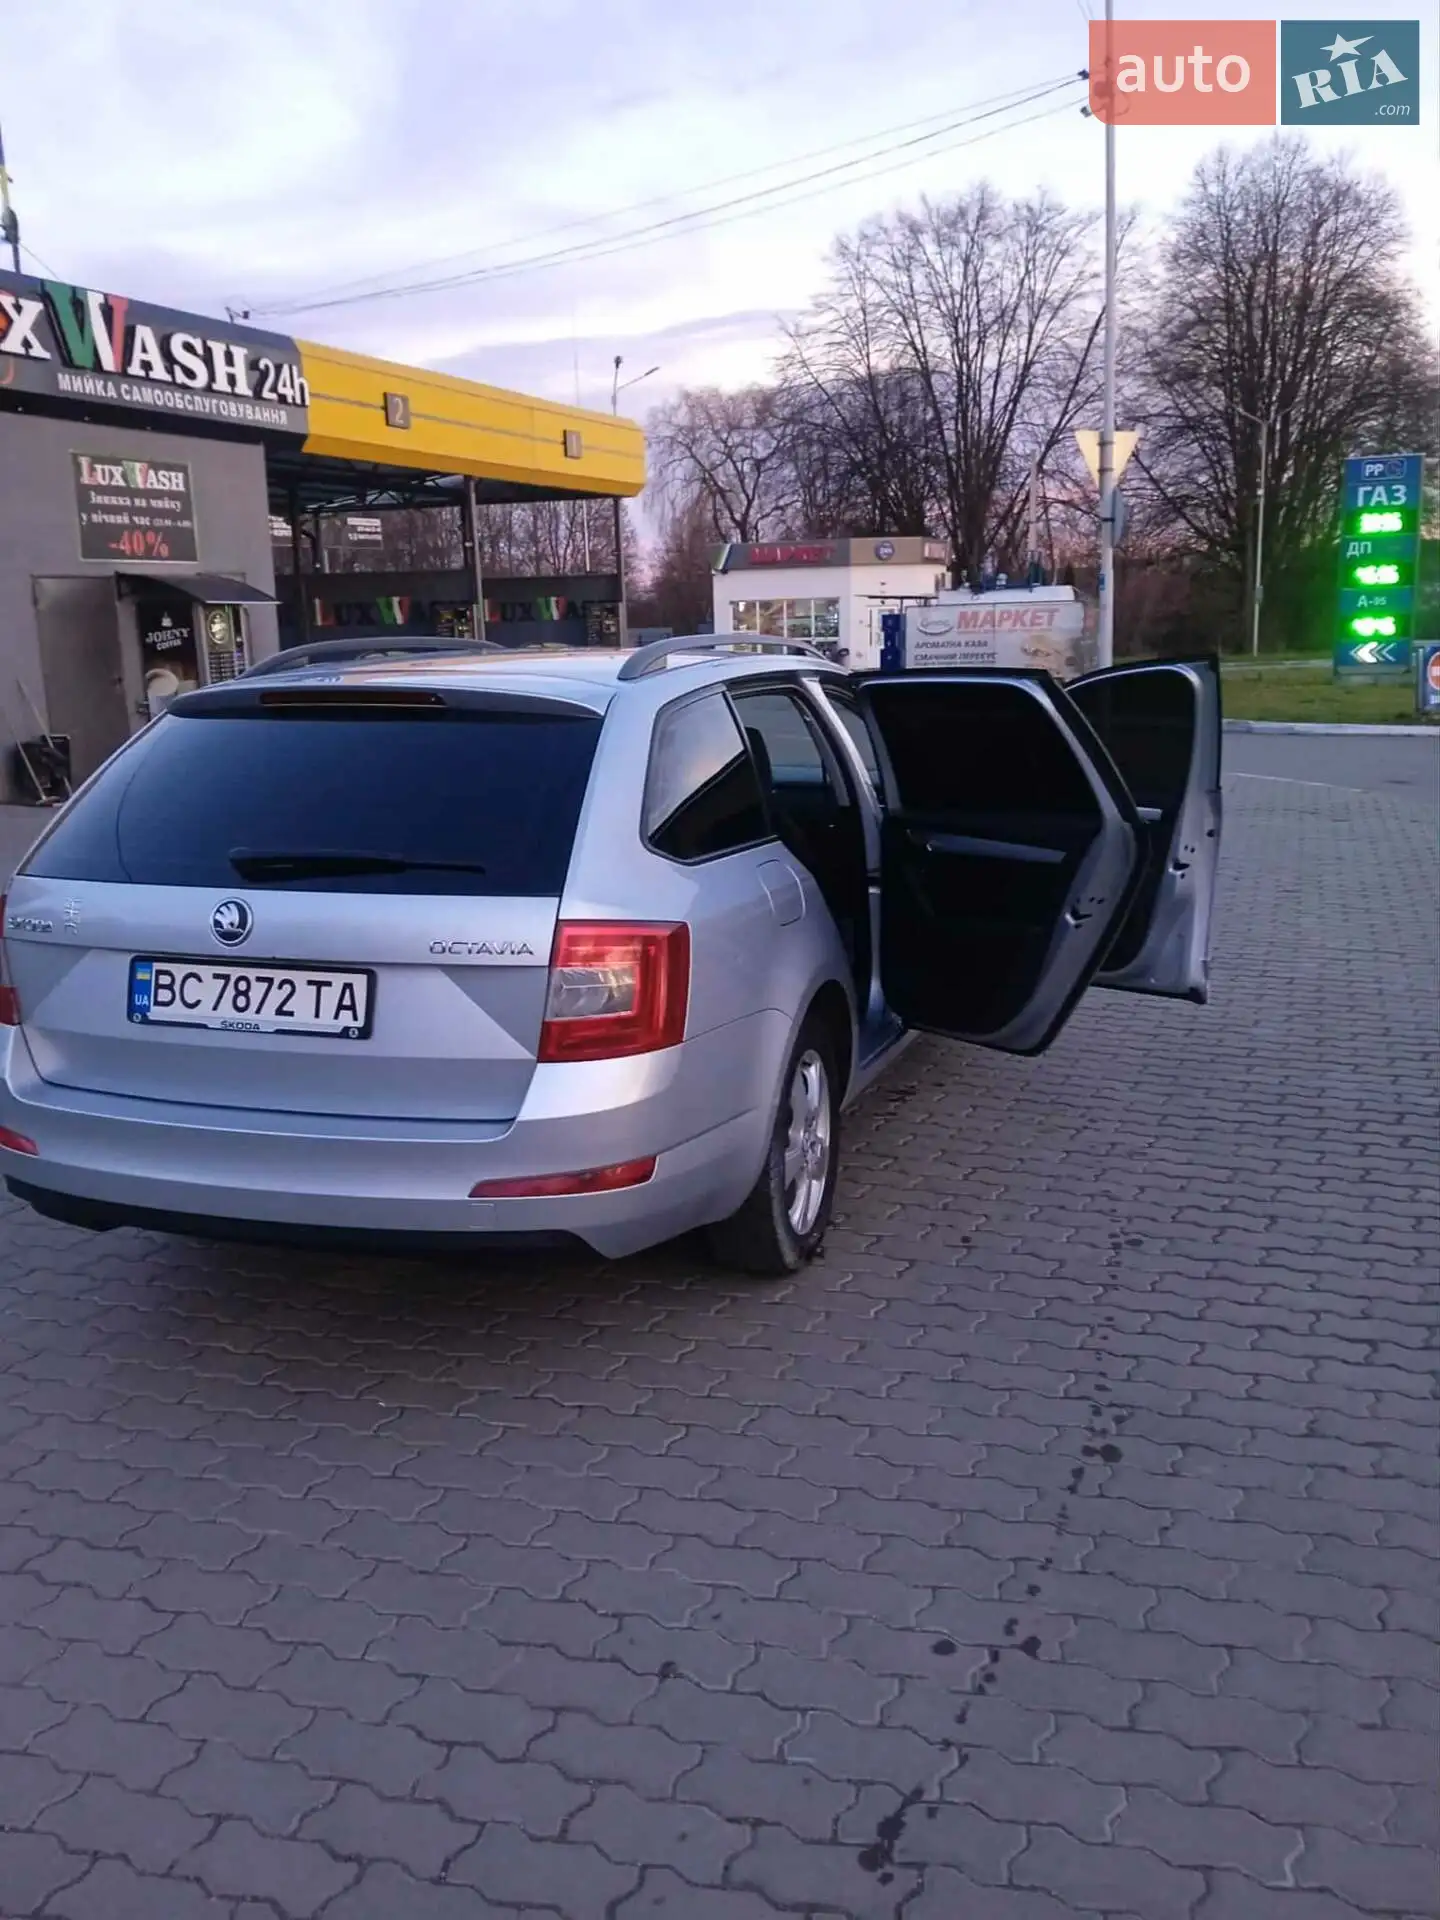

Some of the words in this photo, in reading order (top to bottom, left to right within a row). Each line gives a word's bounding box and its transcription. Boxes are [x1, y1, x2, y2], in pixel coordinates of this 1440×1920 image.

[258, 357, 310, 408] 24h
[57, 371, 118, 400] МИЙКА
[120, 383, 288, 426] САМООБСЛУГОВУВАННЯ
[394, 397, 405, 425] 2
[1356, 484, 1407, 508] ГАЗ
[108, 528, 170, 559] -40%
[1346, 541, 1372, 559] ДП
[955, 606, 1060, 632] МАРКЕТ
[429, 940, 535, 956] OCTAVIA
[134, 993, 150, 1007] UA
[152, 969, 204, 1009] BC
[211, 972, 297, 1017] 7872
[306, 979, 359, 1022] TA
